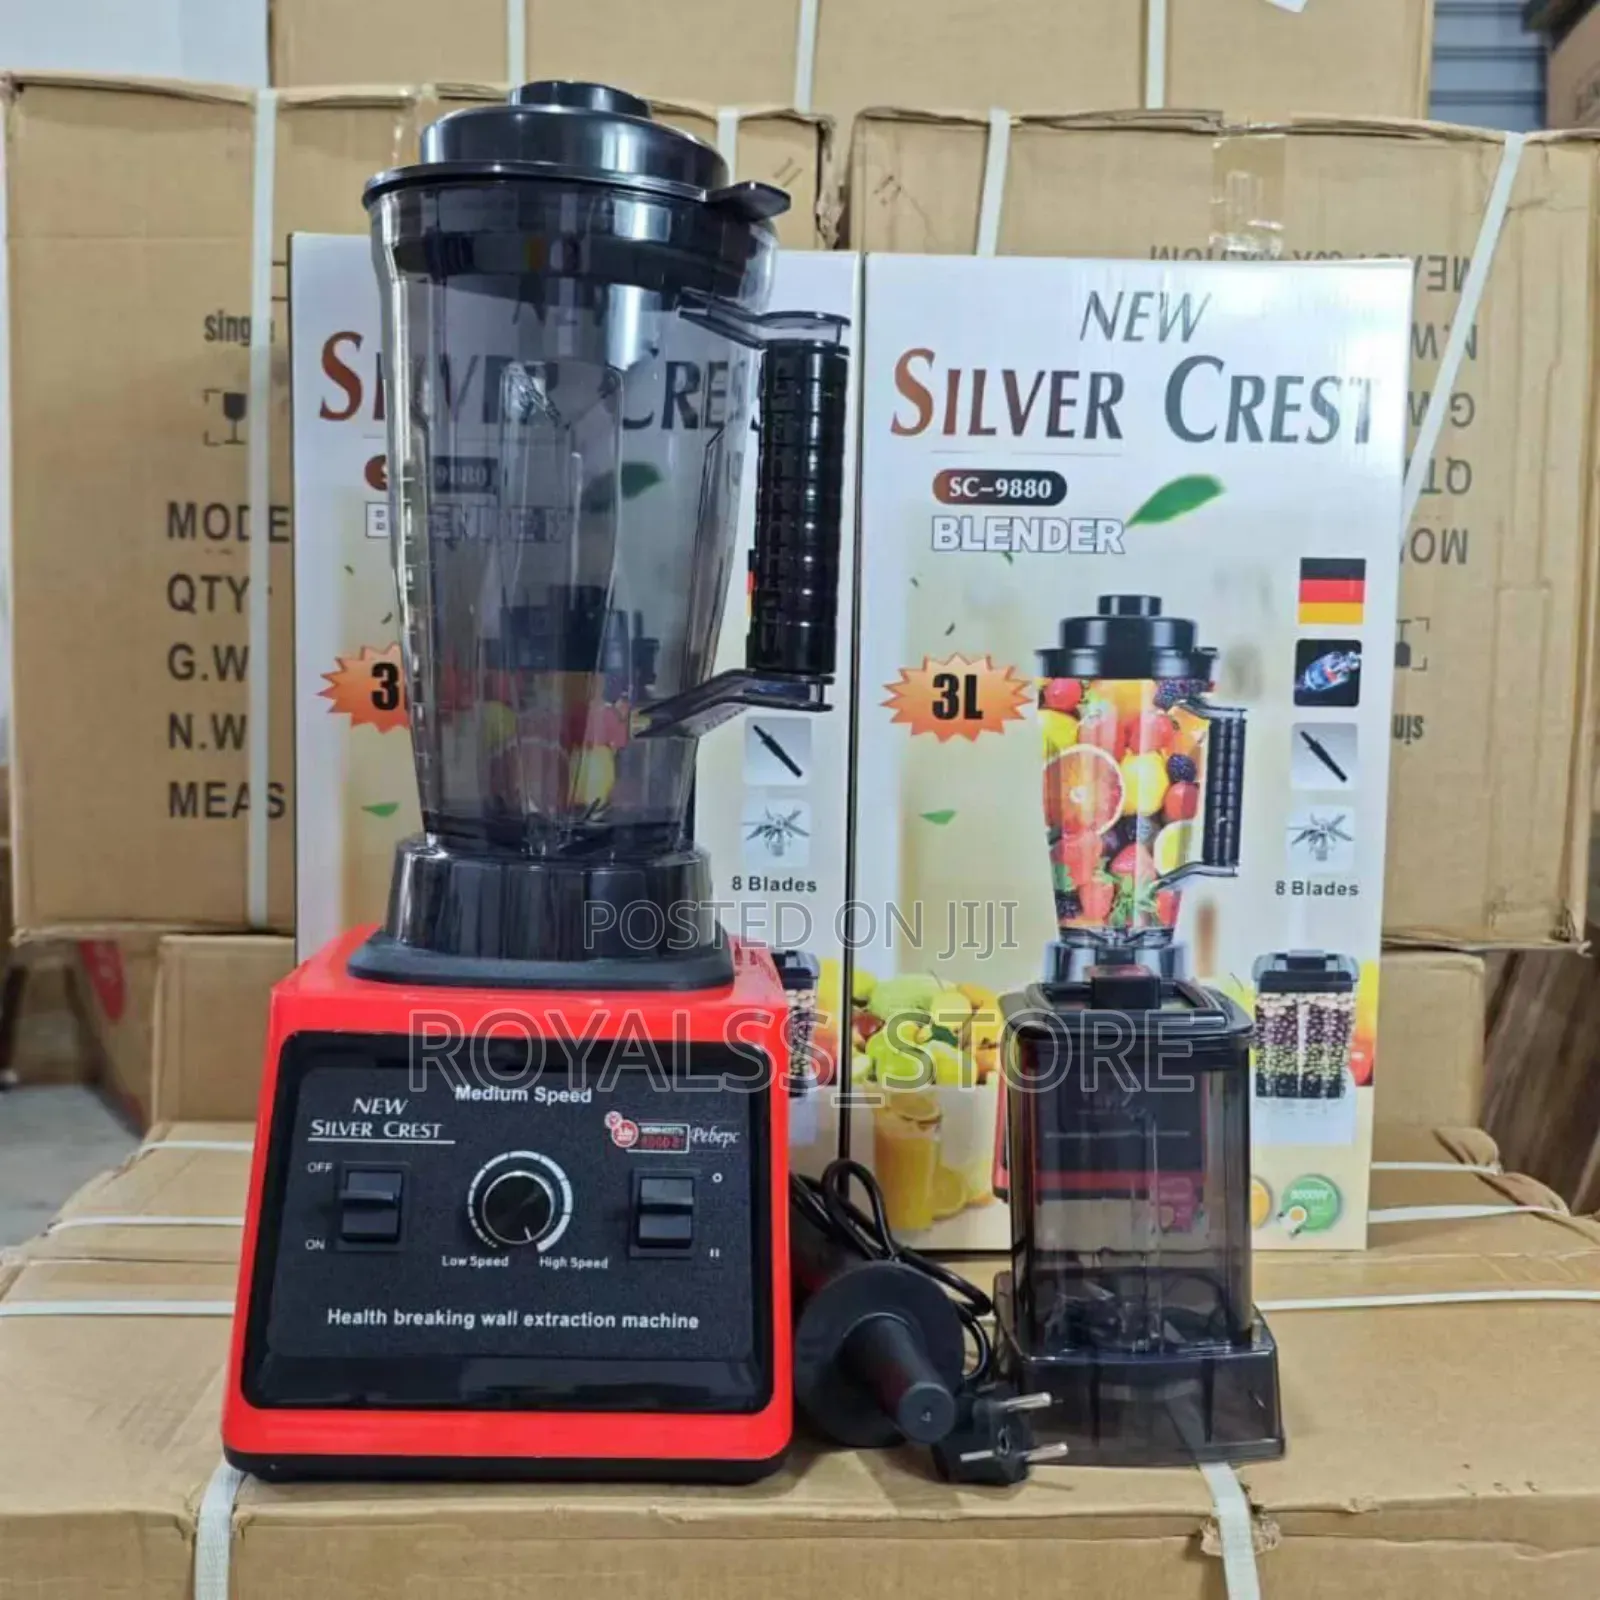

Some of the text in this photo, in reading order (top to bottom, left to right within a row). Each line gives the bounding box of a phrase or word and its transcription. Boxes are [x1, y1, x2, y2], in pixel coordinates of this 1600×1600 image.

[1080, 290, 1211, 342] NEW
[890, 348, 1376, 444] SILVER CREST
[949, 475, 1052, 499] SC-9880
[931, 516, 1126, 554] BLENDER
[932, 673, 983, 720] 3L
[732, 876, 817, 892] 8 Blades
[1275, 880, 1359, 898] 8 Blades
[454, 1085, 592, 1106] Medium Speed
[352, 1097, 409, 1115] NEW
[311, 1119, 444, 1139] SILVER CREST
[307, 1162, 333, 1173] OFF
[305, 1239, 325, 1251] ON
[442, 1256, 509, 1269] Low Speed
[540, 1257, 608, 1271] High Speed
[327, 1308, 700, 1330] Health breaking wall extraction machine
